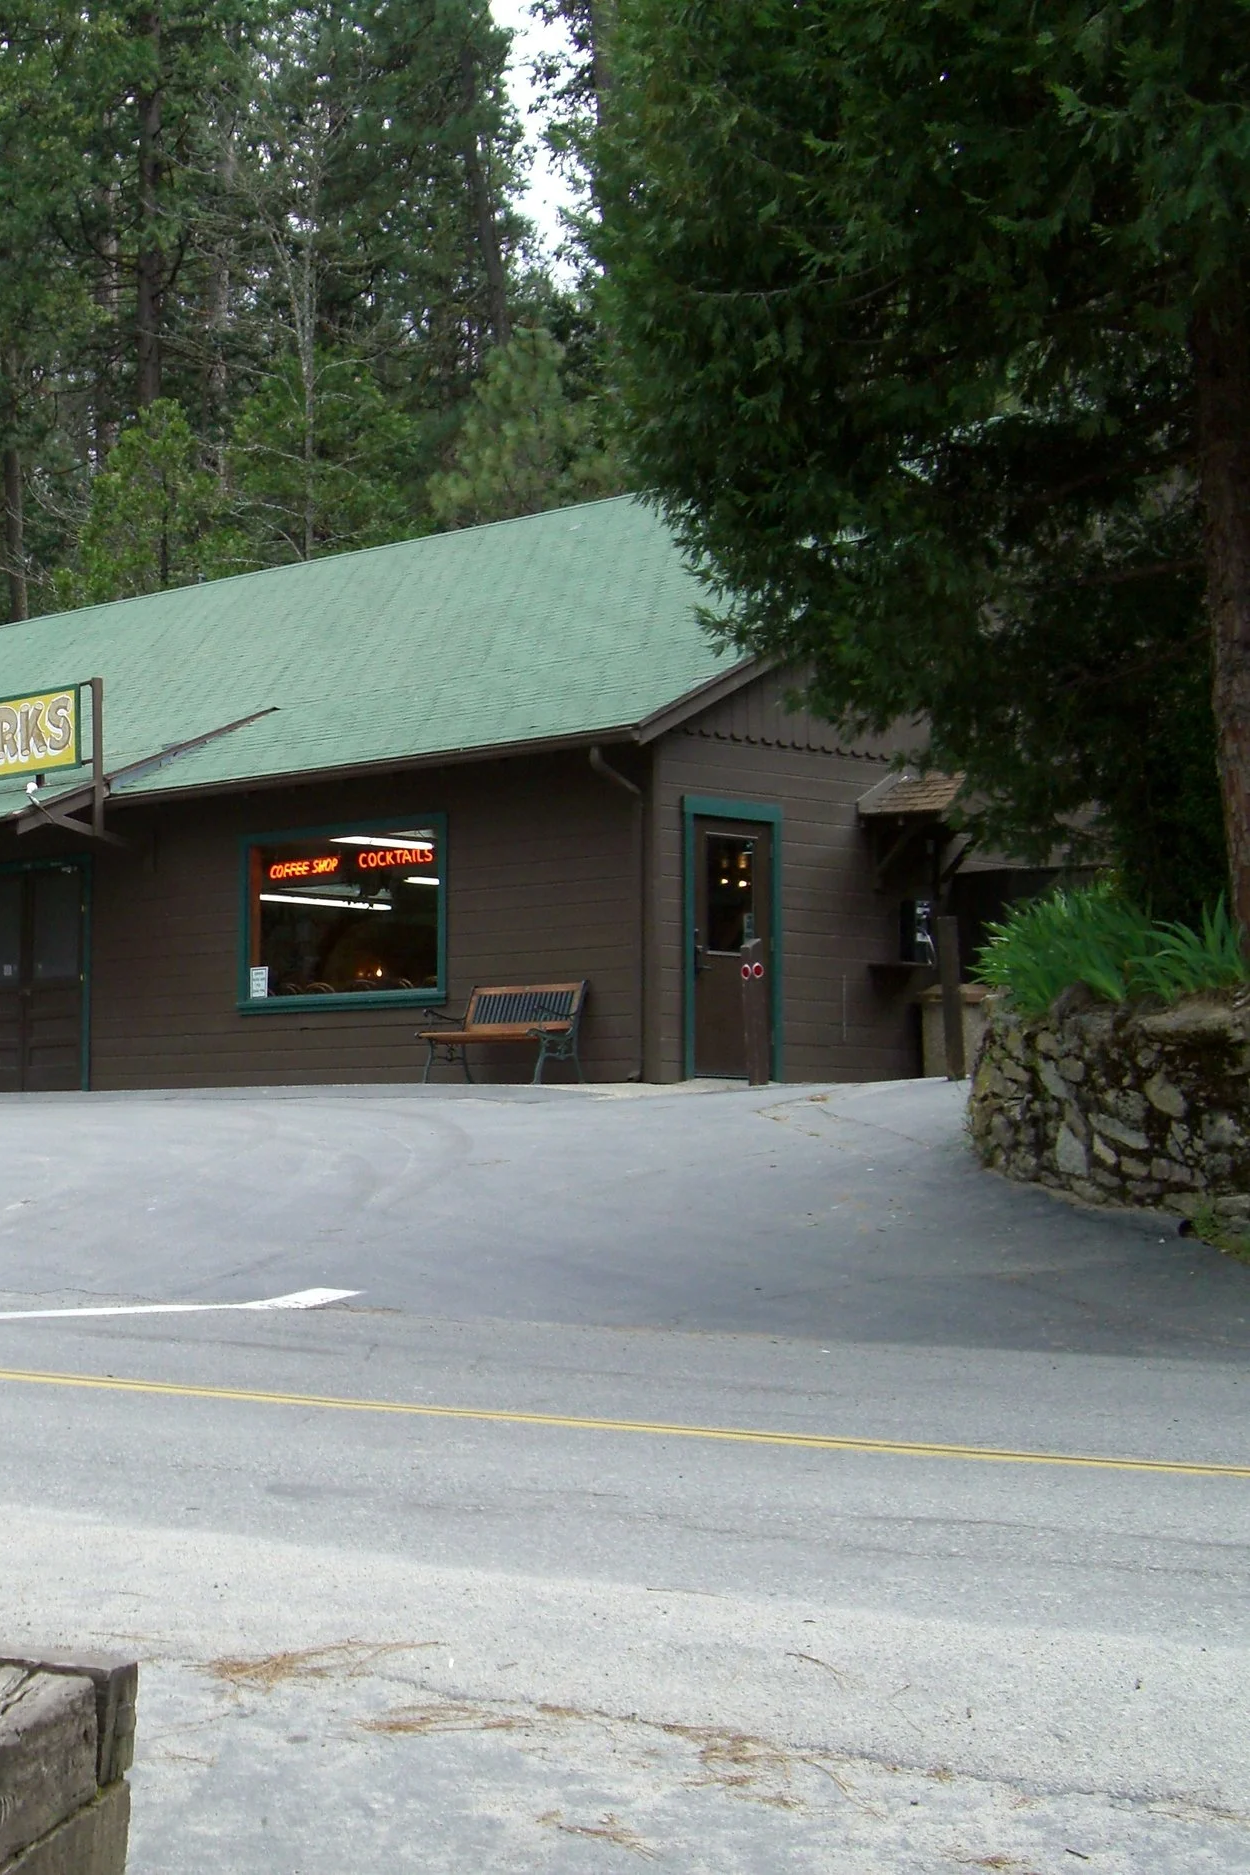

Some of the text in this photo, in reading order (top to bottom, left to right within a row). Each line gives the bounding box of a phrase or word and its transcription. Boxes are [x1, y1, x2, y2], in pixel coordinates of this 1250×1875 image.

[270, 857, 339, 879] COFFEE SHOP
[358, 849, 434, 868] COCKTAILS
